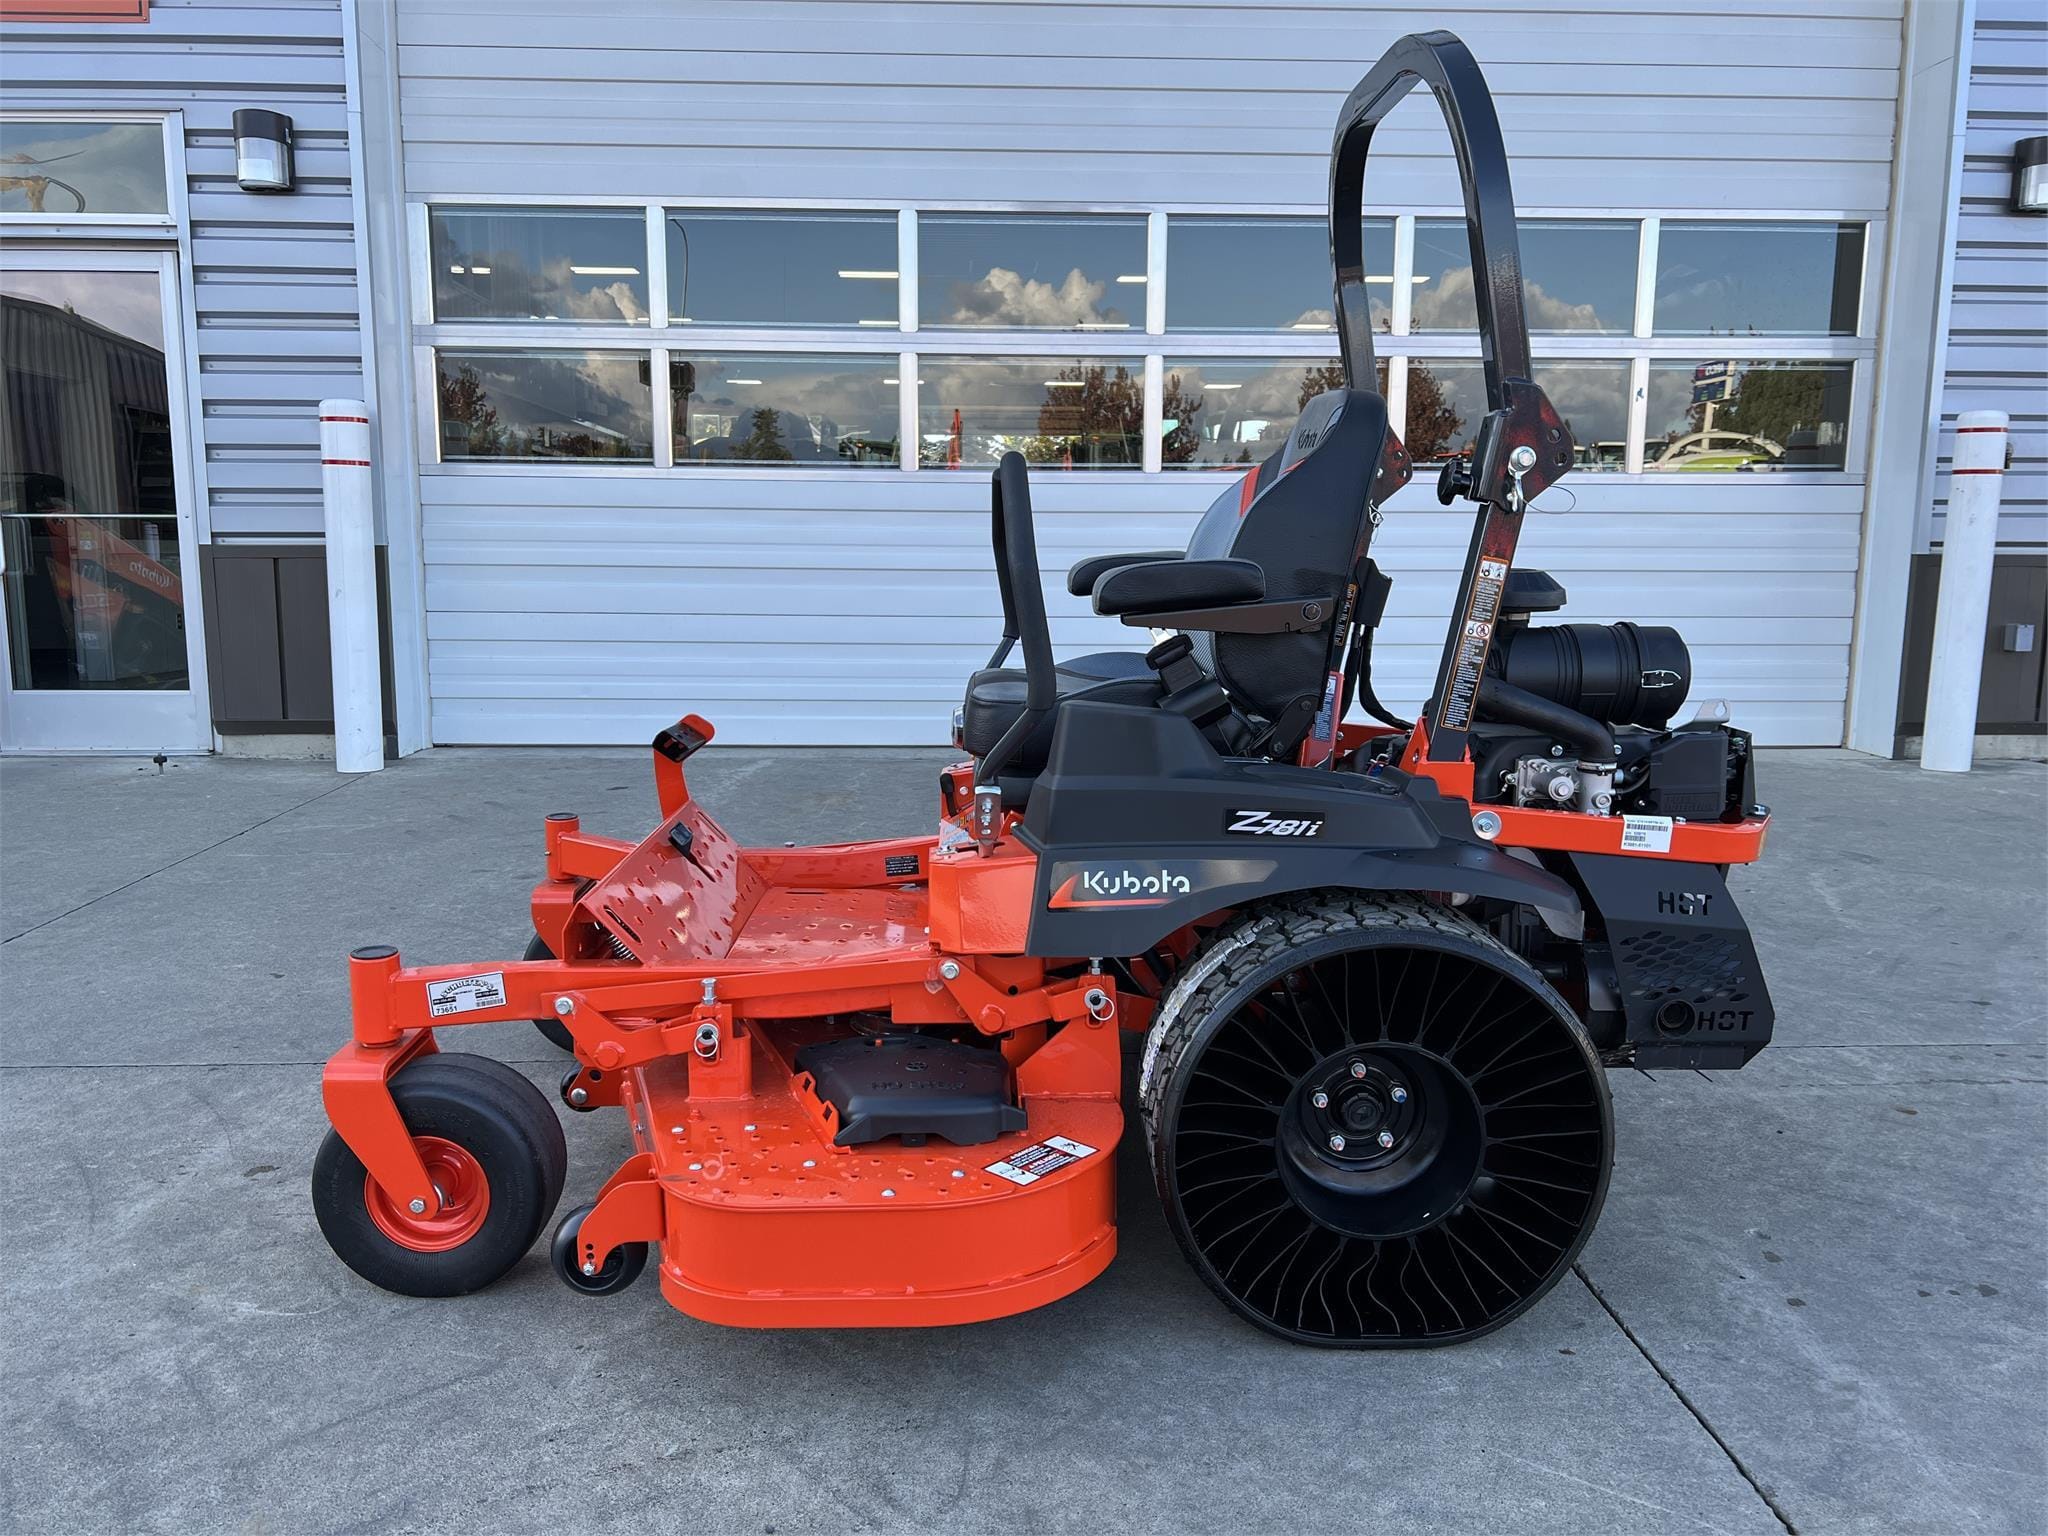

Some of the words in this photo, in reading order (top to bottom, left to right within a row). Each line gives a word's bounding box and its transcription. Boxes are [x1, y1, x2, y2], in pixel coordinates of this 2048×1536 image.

[1227, 810, 1324, 837] Z781i
[1083, 869, 1190, 894] Kubota
[1657, 890, 1713, 916] HOT
[436, 1006, 458, 1014] 73651
[1697, 1010, 1754, 1031] HOT
